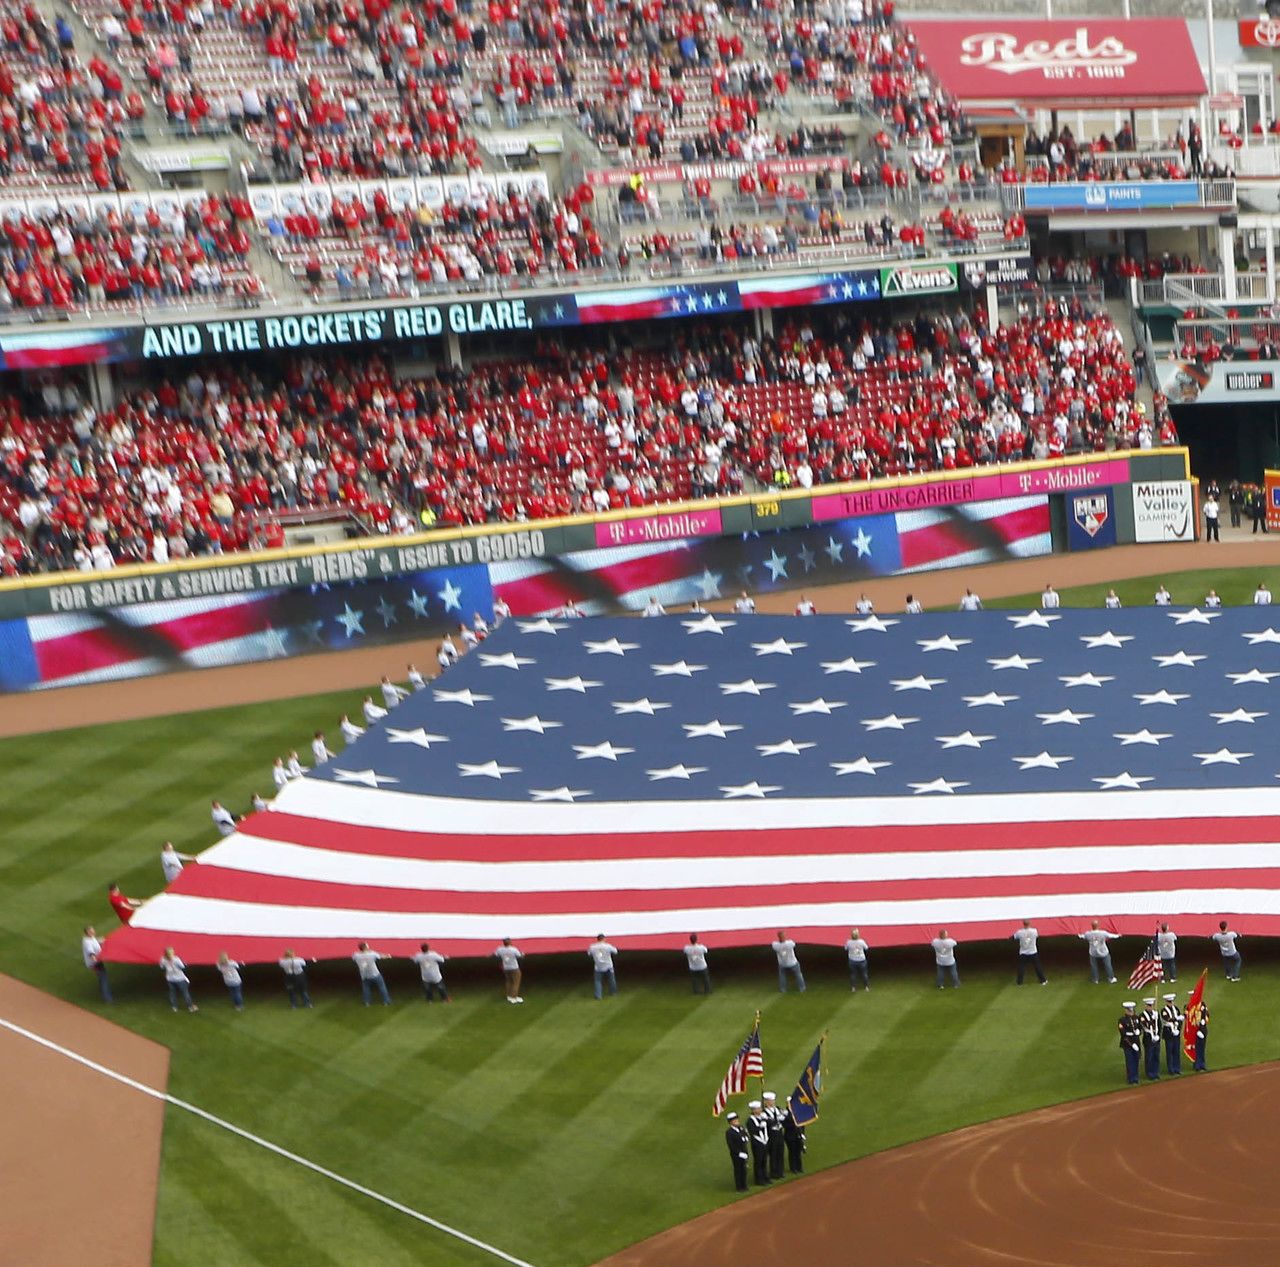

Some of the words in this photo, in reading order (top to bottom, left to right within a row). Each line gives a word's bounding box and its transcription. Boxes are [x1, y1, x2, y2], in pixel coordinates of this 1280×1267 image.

[960, 27, 1137, 74] Reds
[901, 267, 951, 290] Evans
[142, 323, 203, 359] AND
[205, 319, 261, 353] THE
[265, 309, 387, 349] ROCKETS'
[393, 305, 443, 338] RED
[449, 299, 534, 334] GLARE,
[1228, 374, 1262, 389] weber
[1137, 485, 1184, 497] Miami
[842, 493, 873, 513] THE
[1143, 499, 1188, 514] Valley
[50, 585, 88, 612] FOR
[90, 577, 157, 608] SAFETY
[161, 577, 176, 599] &
[178, 566, 255, 596] SERVICE
[257, 559, 300, 587] TEXT
[379, 553, 393, 573] &
[400, 543, 449, 571] ISSUE
[451, 540, 473, 564] TO
[476, 529, 547, 564] 69050
